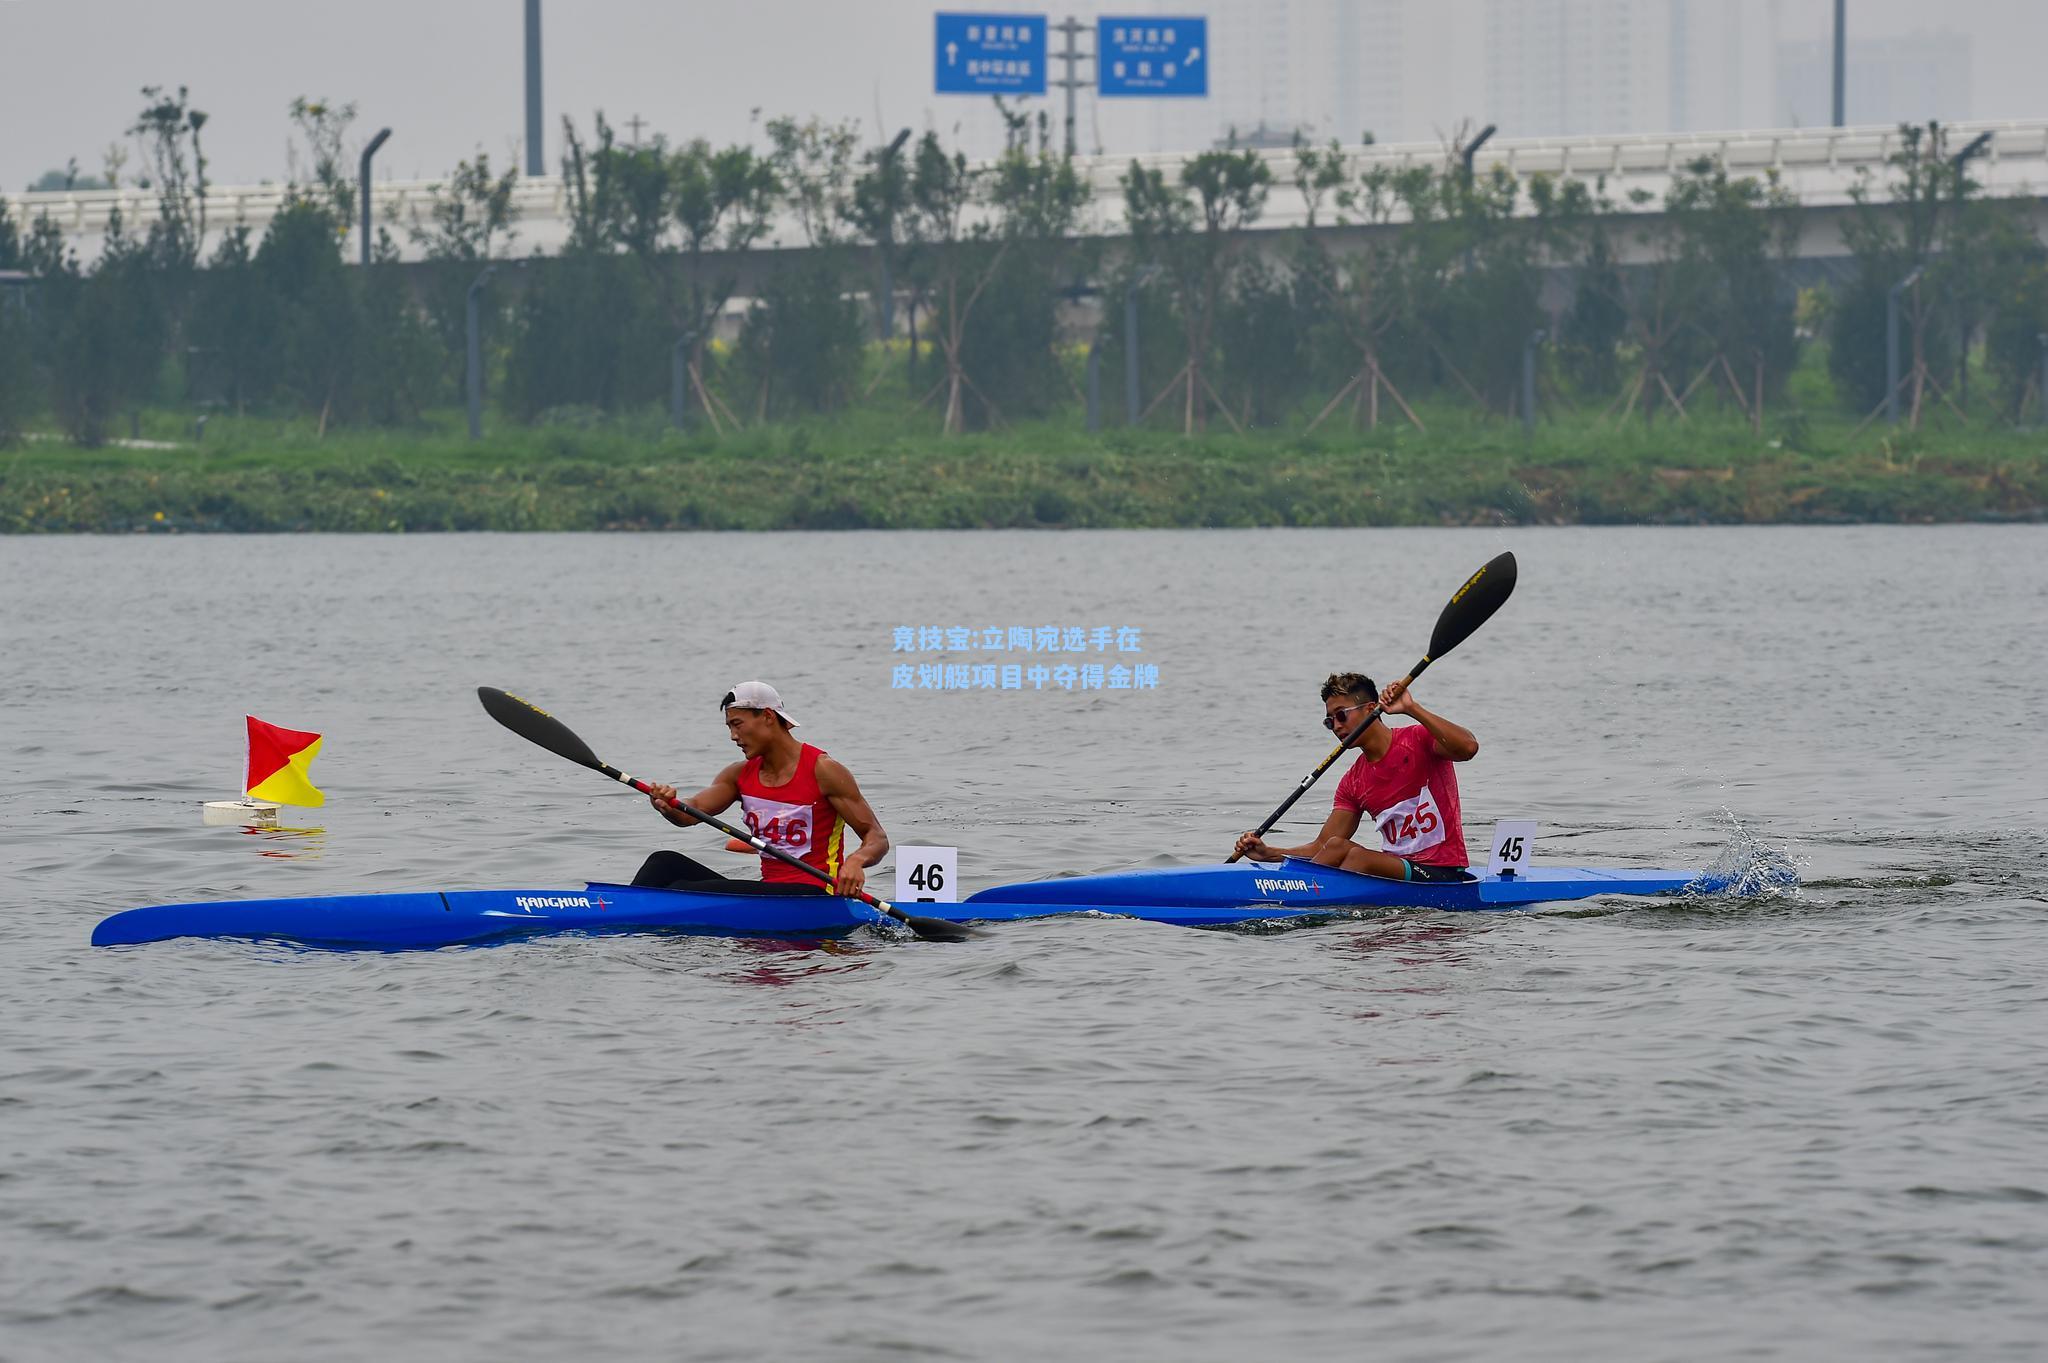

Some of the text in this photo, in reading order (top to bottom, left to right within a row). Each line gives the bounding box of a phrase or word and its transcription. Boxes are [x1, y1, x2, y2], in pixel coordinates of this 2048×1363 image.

[745, 811, 808, 847] 046
[1381, 801, 1438, 845] 045
[1498, 837, 1525, 863] 45
[908, 863, 944, 892] 46
[1254, 878, 1309, 897] KANGHUA
[515, 896, 591, 914] KANGHUA
